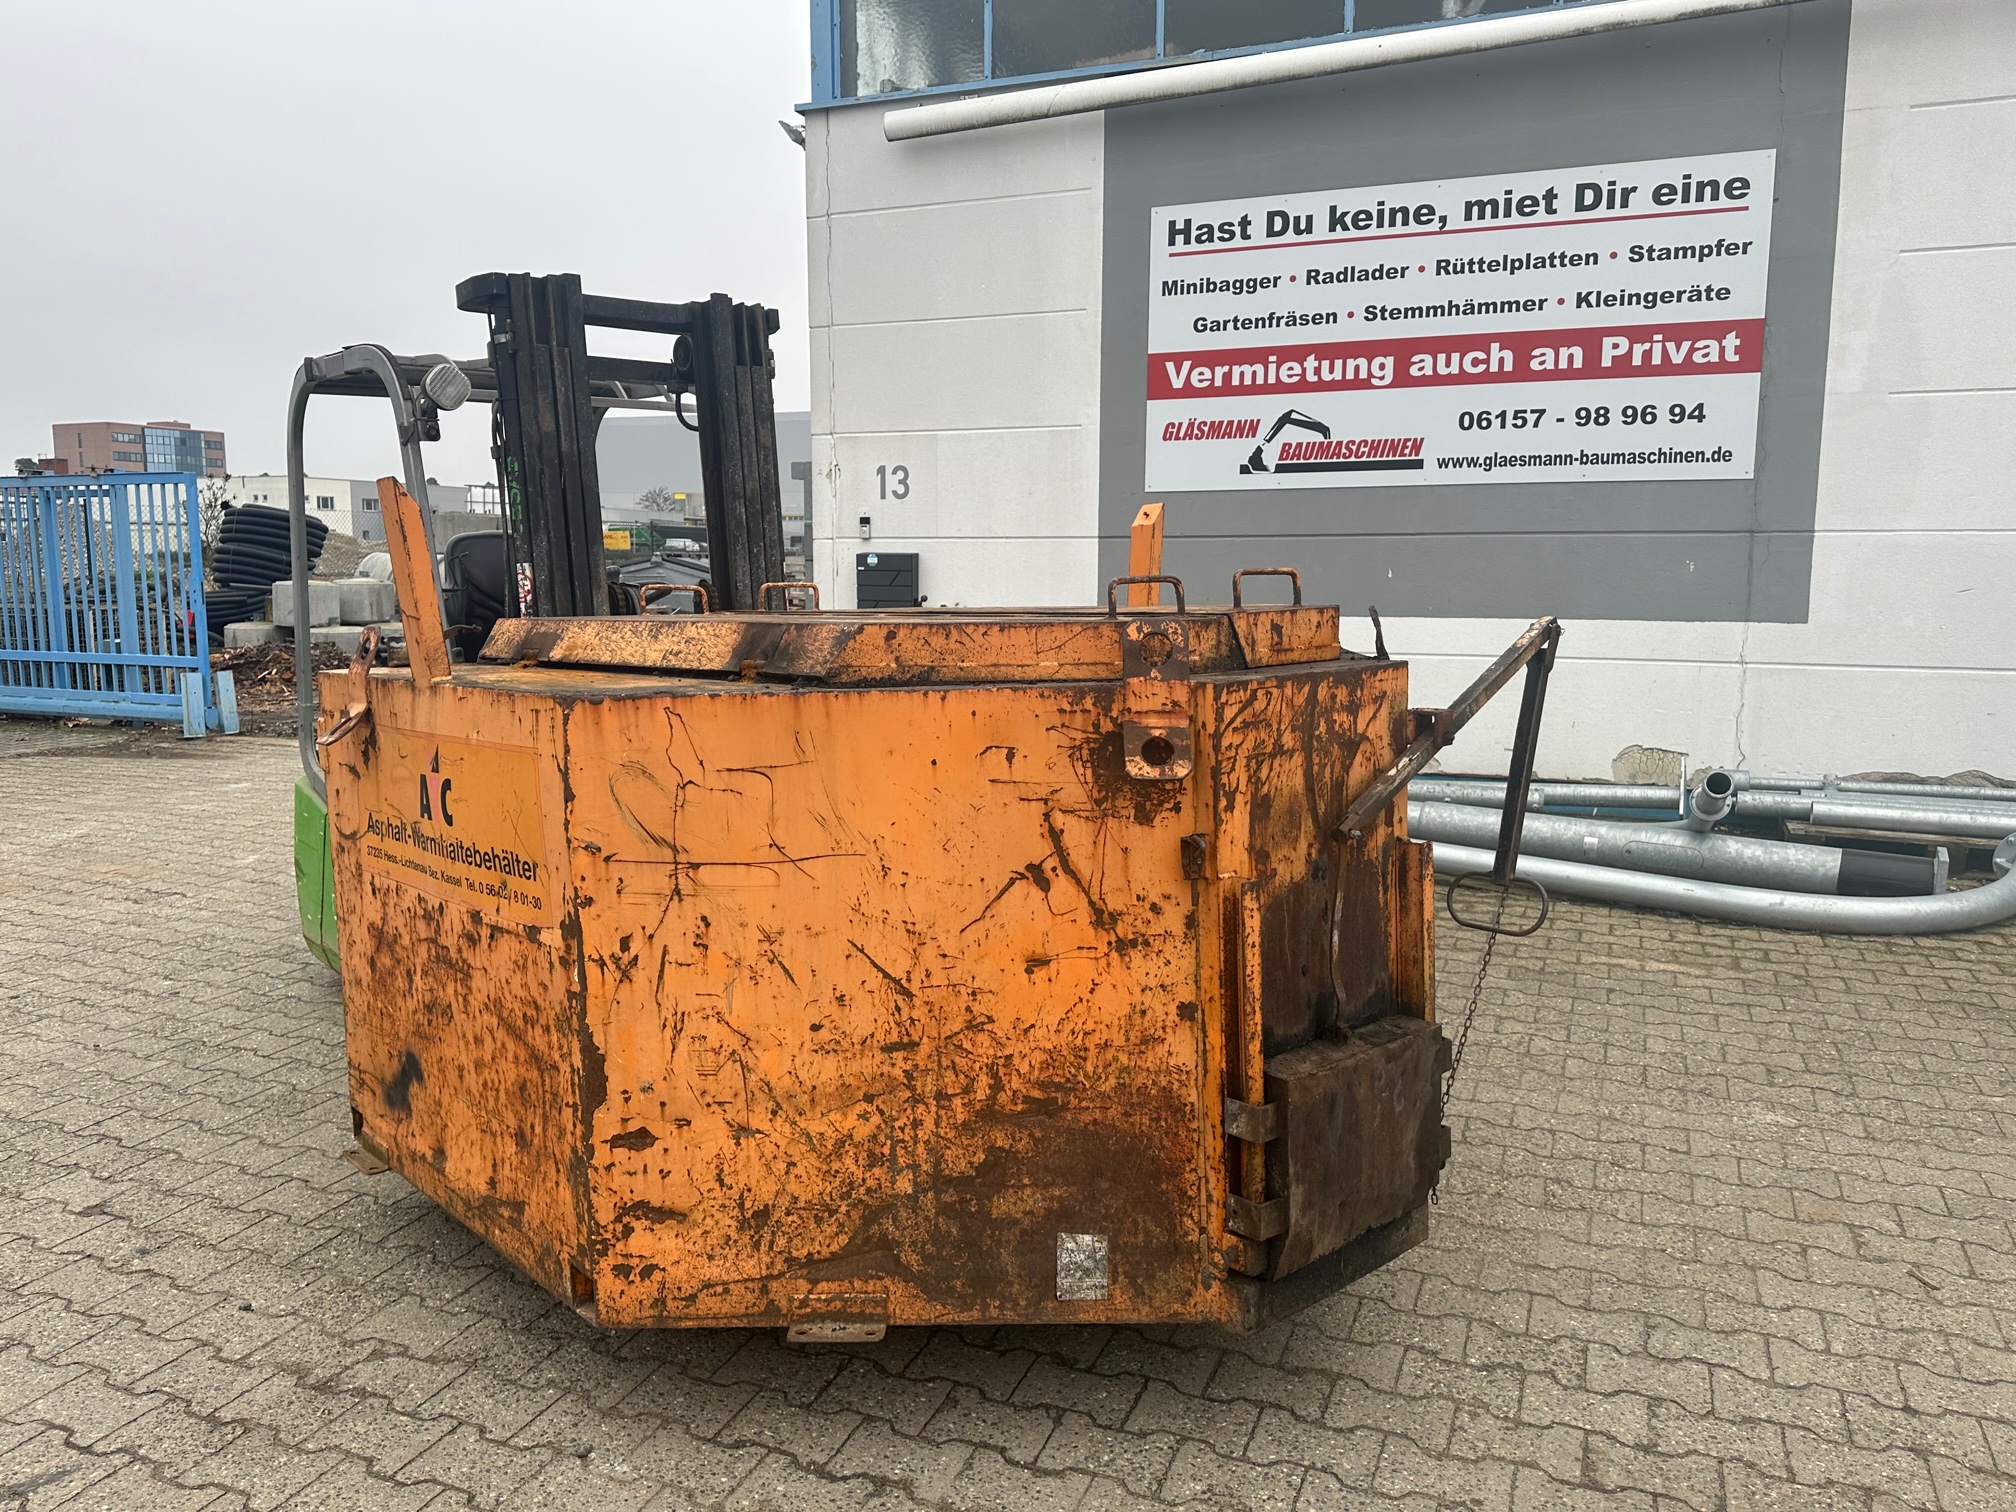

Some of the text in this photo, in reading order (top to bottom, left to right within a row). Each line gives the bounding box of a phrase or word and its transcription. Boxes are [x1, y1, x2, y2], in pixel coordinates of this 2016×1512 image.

[1168, 173, 1751, 246] Hast Du keine, miet Dir eine
[1161, 238, 1753, 297] Minibagger Radlader Rüttelplatten Stampfer
[1193, 284, 1731, 333] Gartenfräsen Stemmhämmer Kleingeräte
[1165, 330, 1741, 389] Vermietung auch an Privat
[1162, 418, 1261, 442] GLÄSMANN
[1458, 408, 1546, 431] 06157
[1574, 406, 1610, 427] 98
[1621, 404, 1658, 426] 96
[1668, 402, 1706, 424] 94
[1278, 437, 1424, 462] BAUMASCHINEN
[1436, 446, 1733, 472] www.glaesmann-baumaschinen.de
[876, 464, 910, 500] 13
[440, 870, 463, 888] Kassel
[465, 877, 478, 893] Tel.
